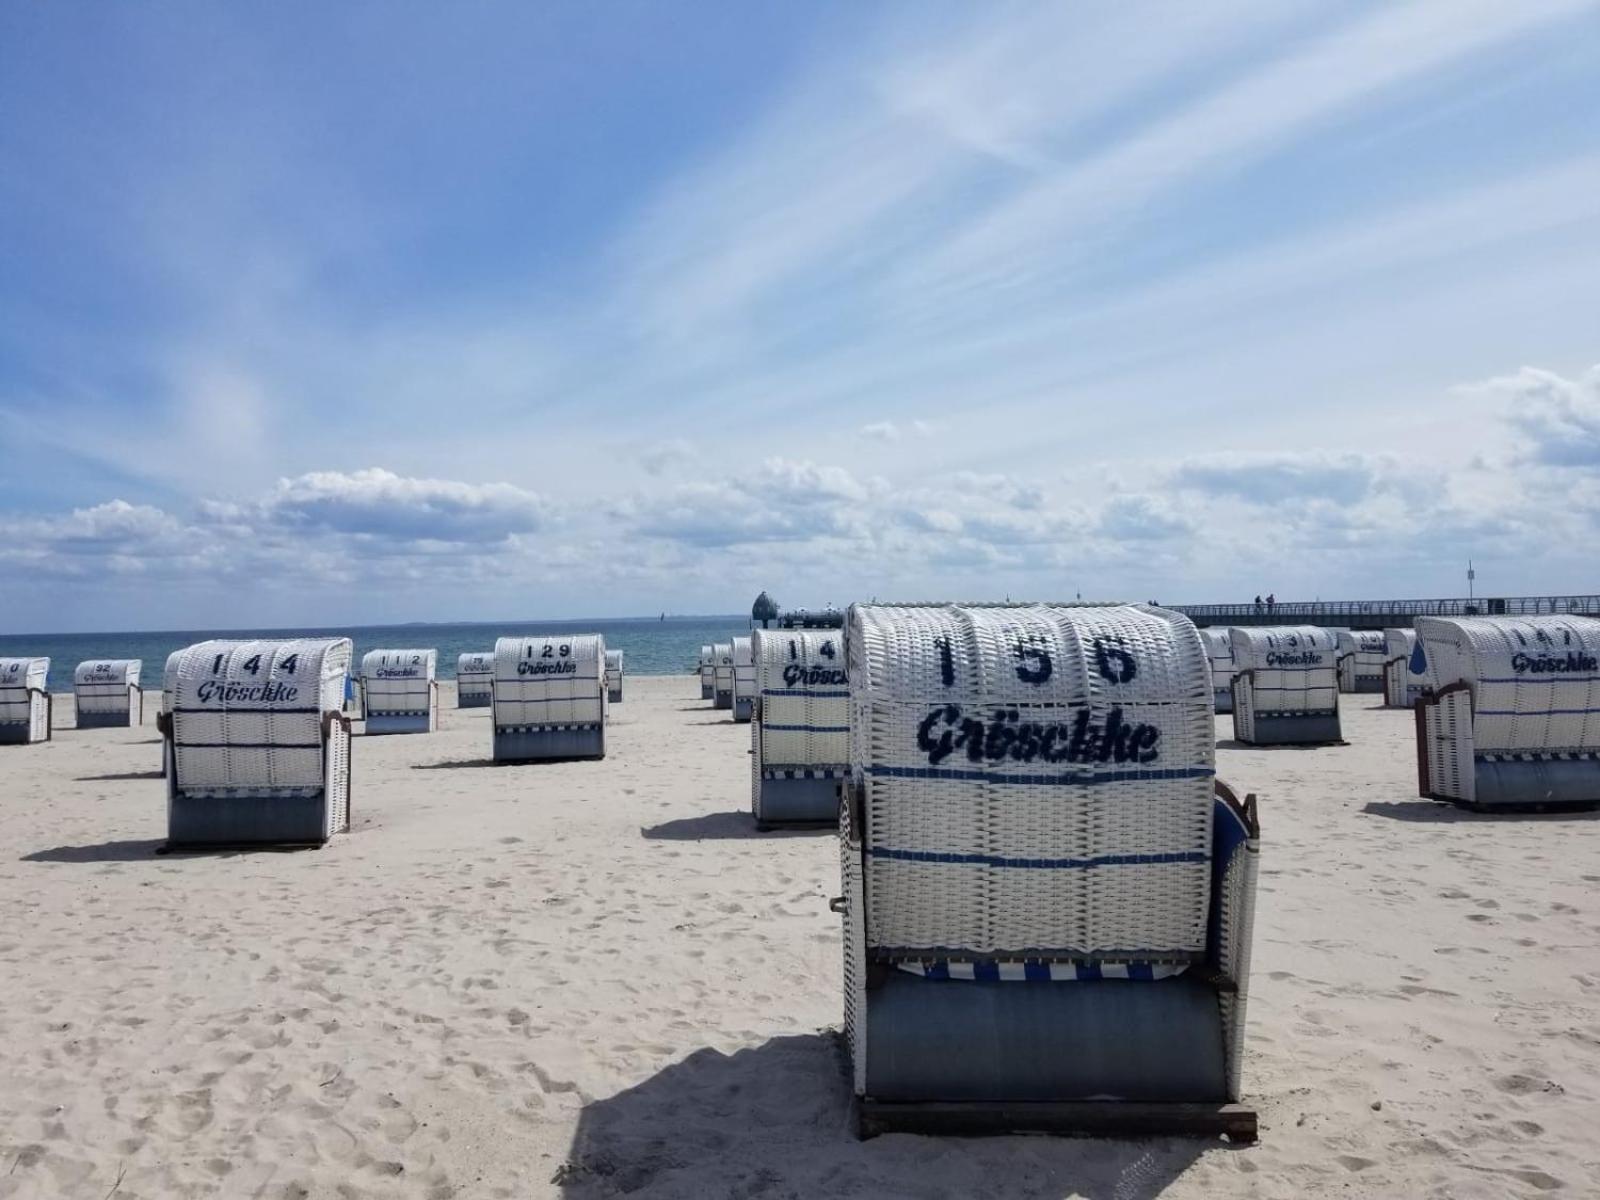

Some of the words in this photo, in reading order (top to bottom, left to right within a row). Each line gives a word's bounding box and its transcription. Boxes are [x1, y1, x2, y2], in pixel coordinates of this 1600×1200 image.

[527, 644, 571, 658] 129
[788, 640, 836, 660] 14
[1267, 634, 1316, 648] 131
[213, 654, 299, 675] 144
[382, 655, 420, 665] 112
[934, 635, 1137, 687] 156
[783, 664, 849, 687] Grösc
[197, 680, 298, 703] Gröschke
[917, 705, 1160, 764] Gröschke
